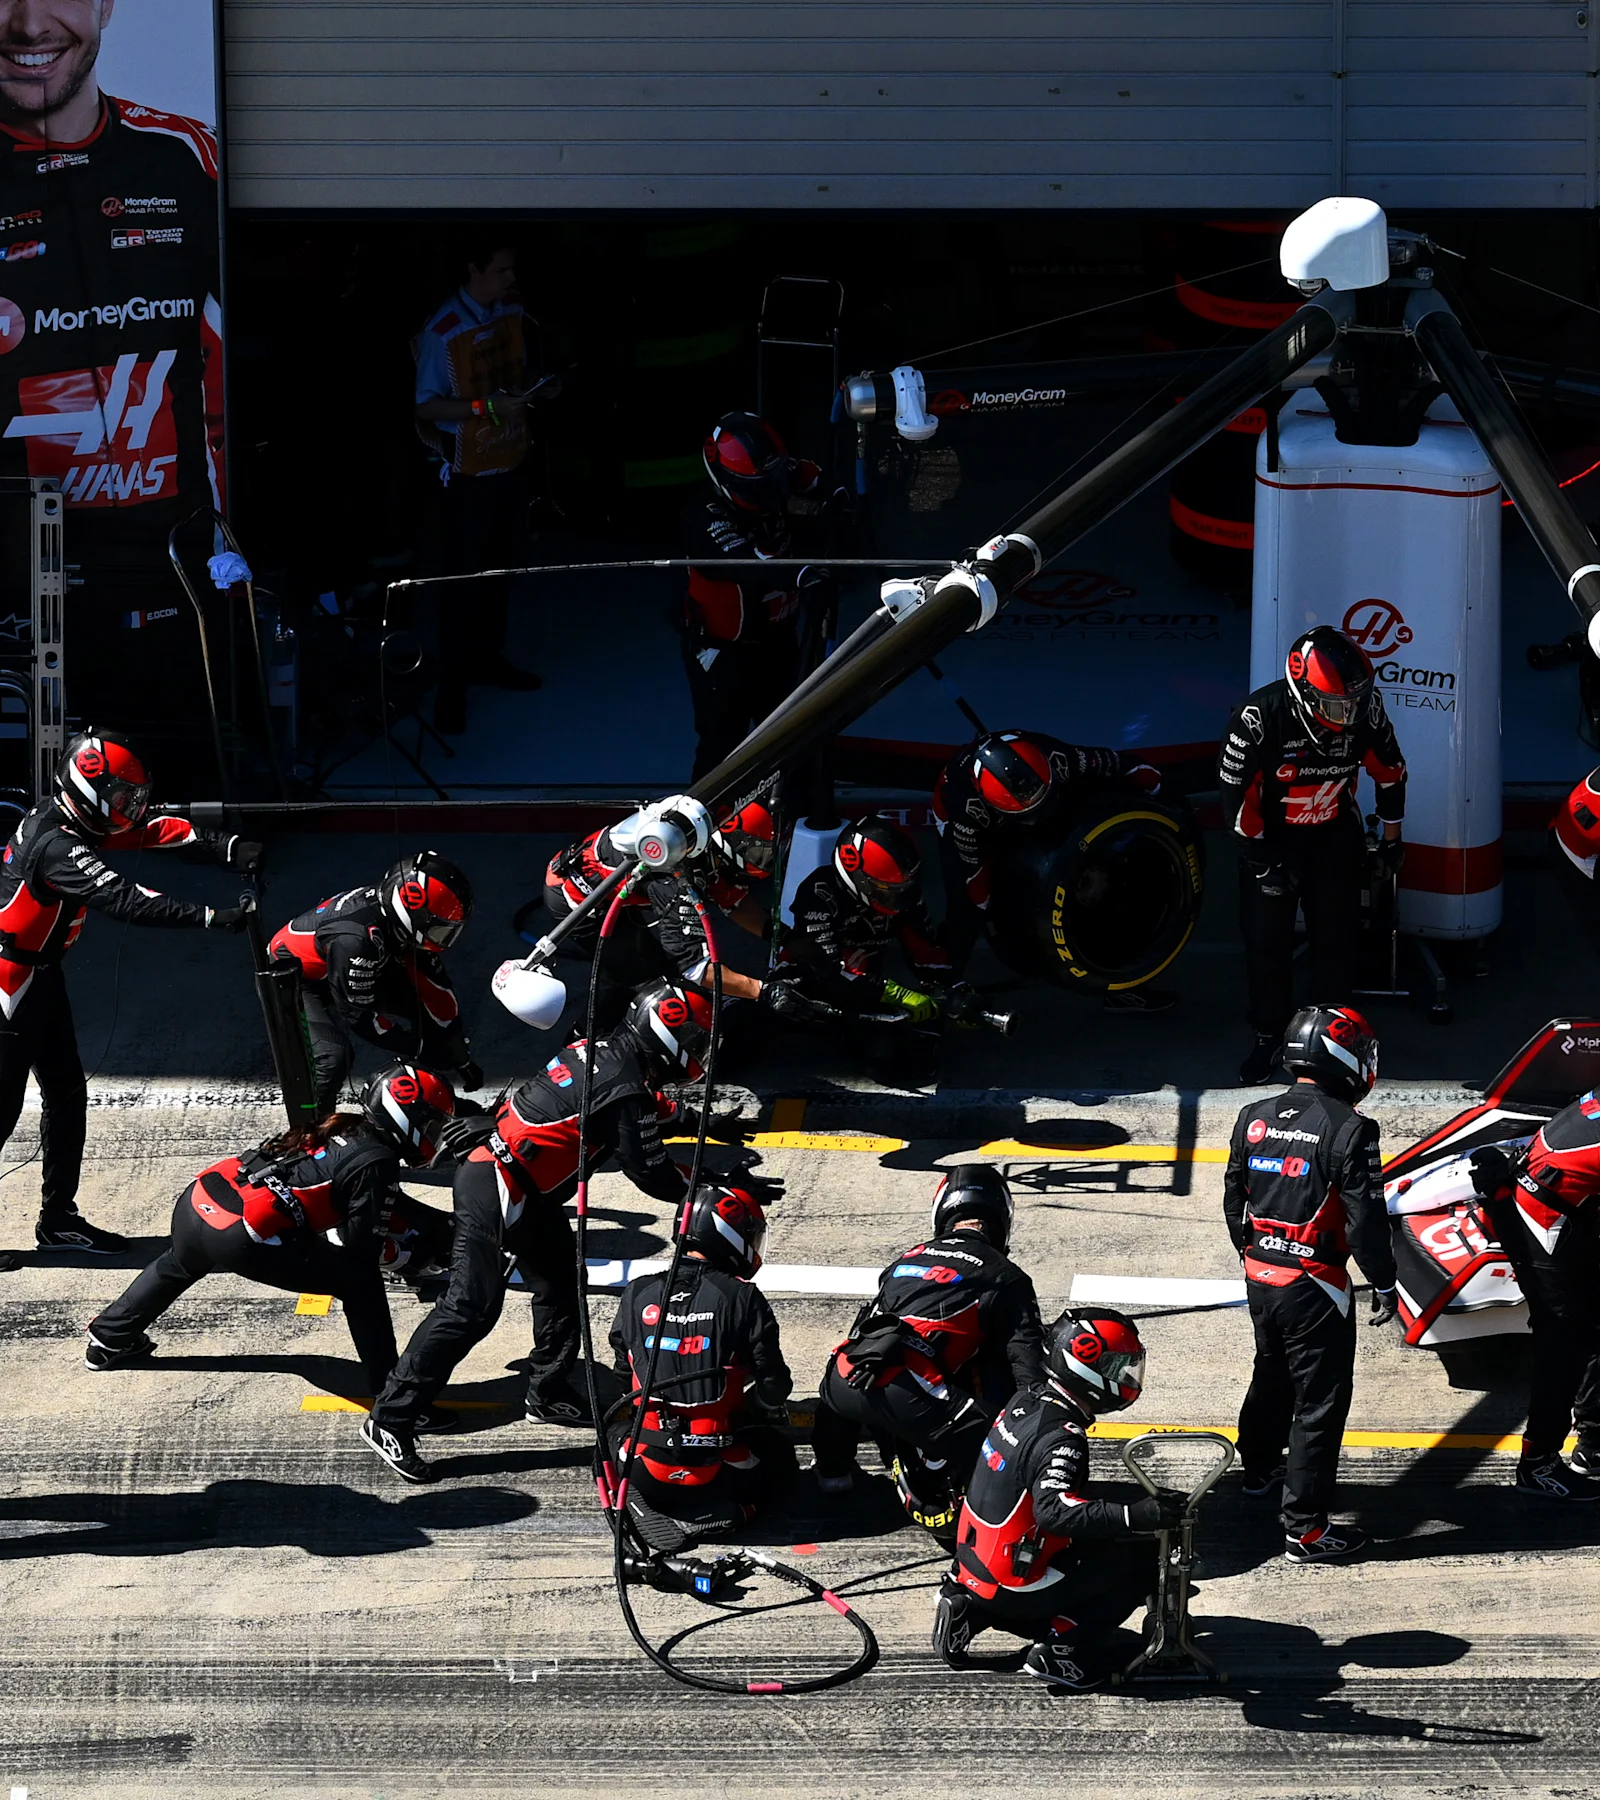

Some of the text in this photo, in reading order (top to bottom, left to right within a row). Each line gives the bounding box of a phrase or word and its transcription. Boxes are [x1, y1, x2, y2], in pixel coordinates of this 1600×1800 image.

[125, 197, 176, 209] MoneyGram
[112, 236, 145, 247] GR
[34, 297, 194, 333] MoneyGram
[972, 388, 1066, 406] MoneyGram
[60, 454, 178, 502] HAAS
[991, 611, 1219, 629] neyGram
[1107, 631, 1220, 642] TEAM
[1391, 692, 1455, 712] TEAM
[1284, 803, 1338, 824] HAAS
[1050, 884, 1089, 979] P ZERO
[1266, 1125, 1320, 1145] MoneyGram
[665, 1312, 714, 1325] oneyGram
